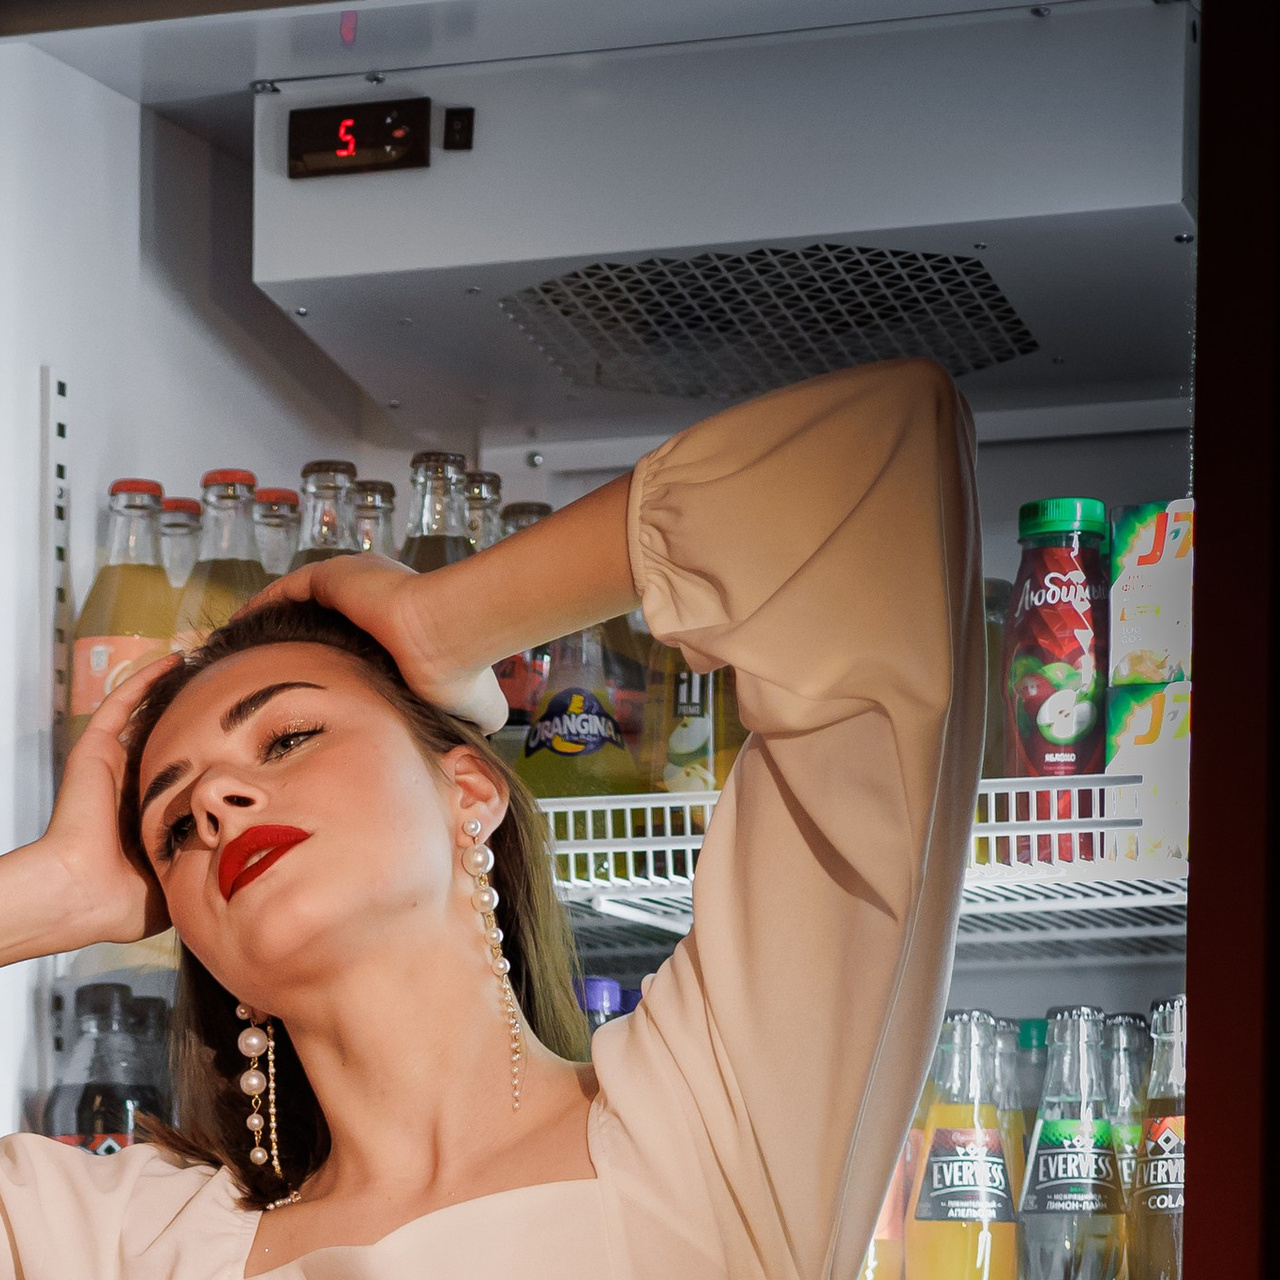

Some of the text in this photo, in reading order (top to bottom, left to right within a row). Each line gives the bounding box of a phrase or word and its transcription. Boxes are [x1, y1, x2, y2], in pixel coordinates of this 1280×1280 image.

[528, 711, 617, 748] ORANGINA
[932, 1160, 1006, 1190] EVERVESS
[1037, 1151, 1115, 1183] EVERVESS
[1147, 1194, 1185, 1210] COLA
